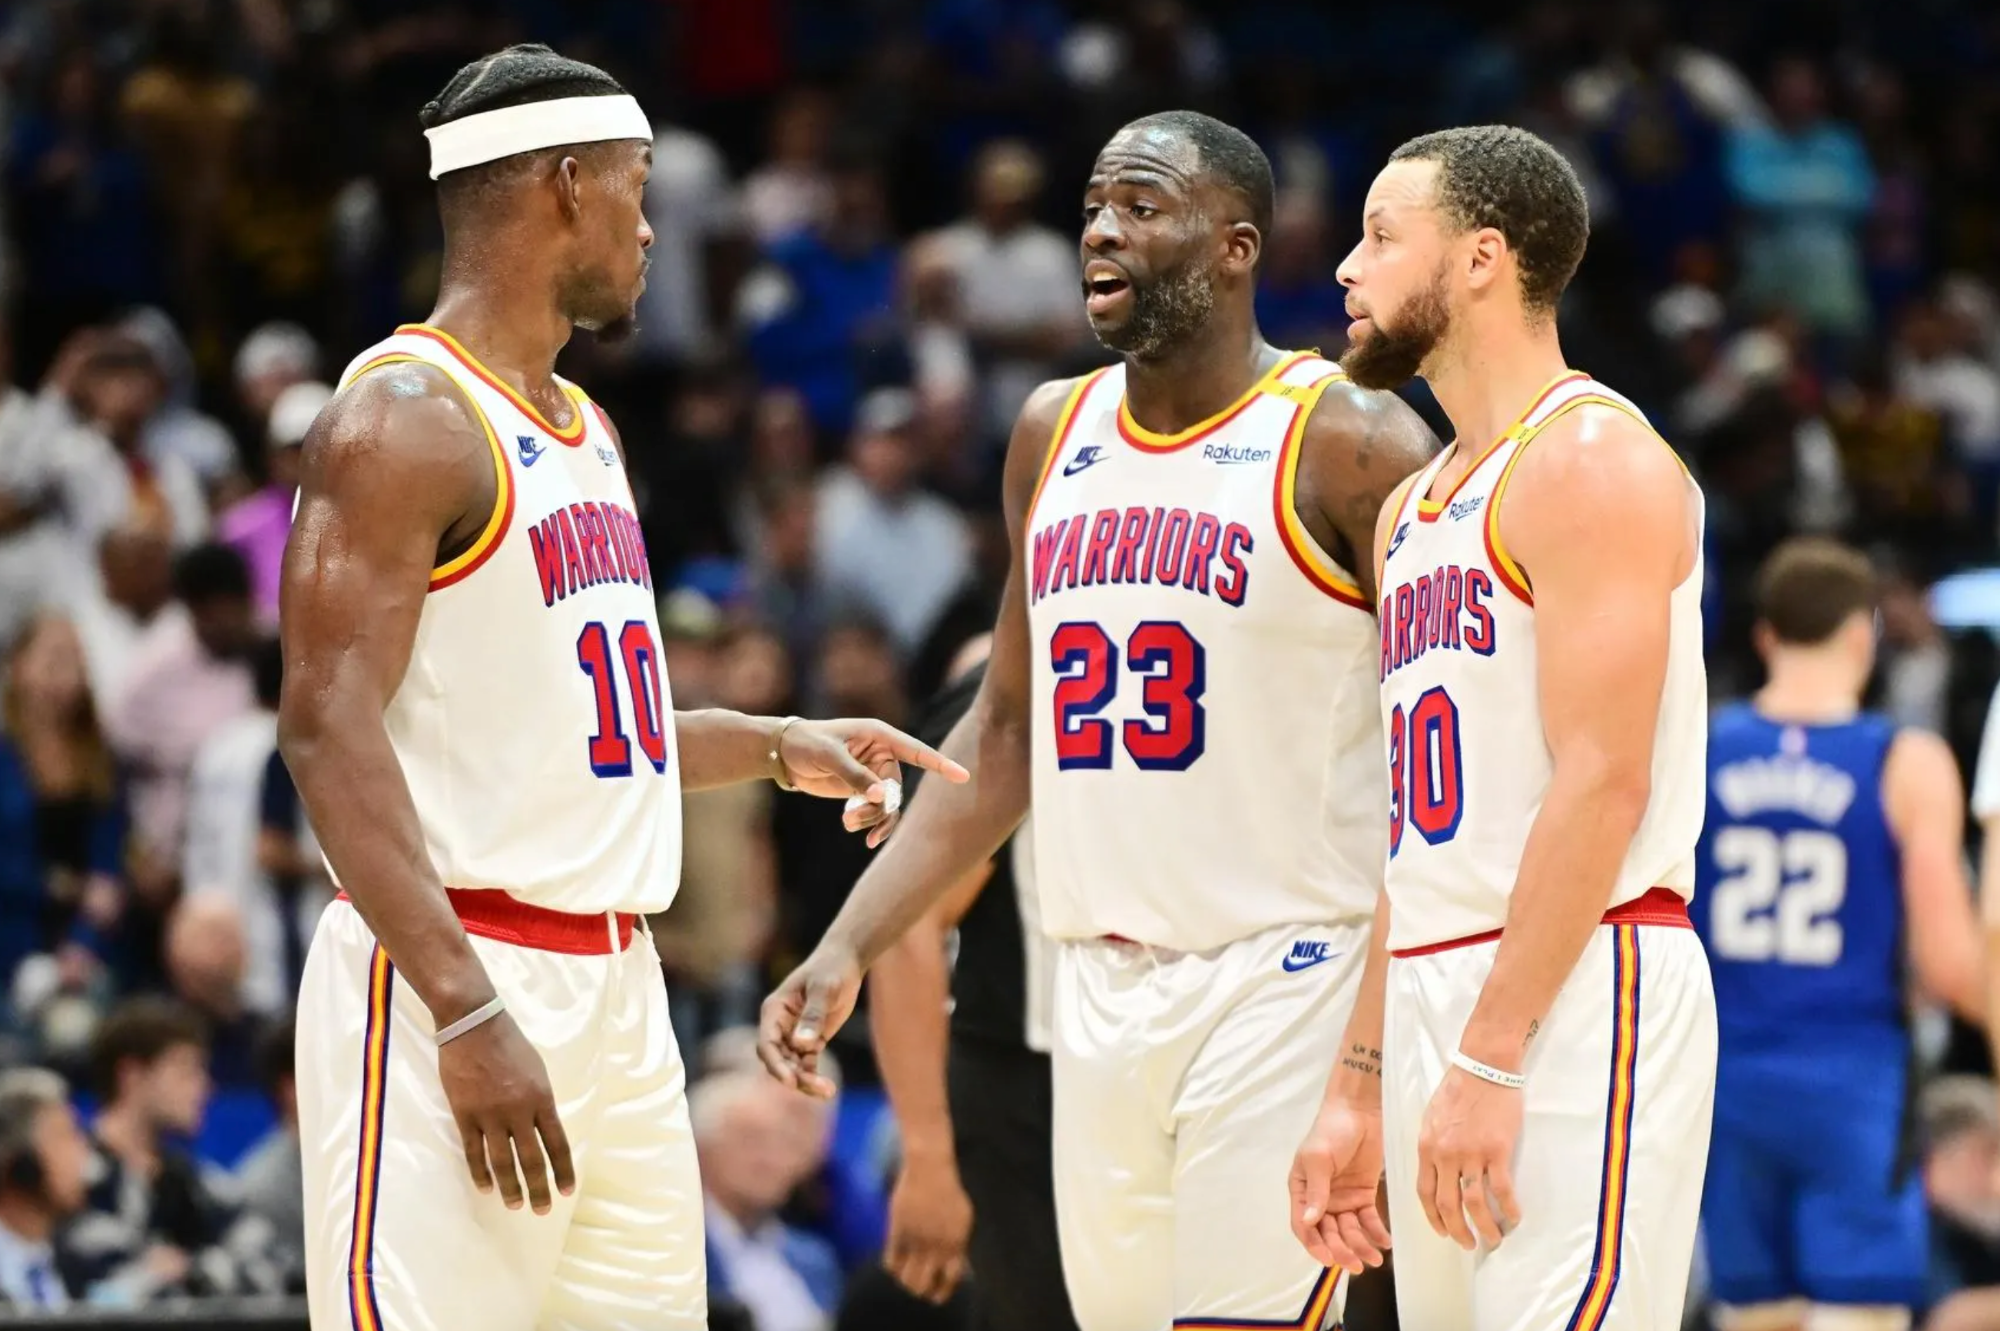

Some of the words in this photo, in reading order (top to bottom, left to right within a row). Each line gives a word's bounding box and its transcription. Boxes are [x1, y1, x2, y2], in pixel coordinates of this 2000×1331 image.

[1203, 443, 1271, 462] Rakuten
[528, 501, 653, 608] WARRIOR
[1032, 506, 1254, 608] WARRIORS
[1379, 565, 1496, 684] ARRORS
[576, 619, 667, 778] 10
[1050, 621, 1206, 771] 23
[1290, 940, 1331, 960] NIKE
[1711, 825, 1847, 968] 22
